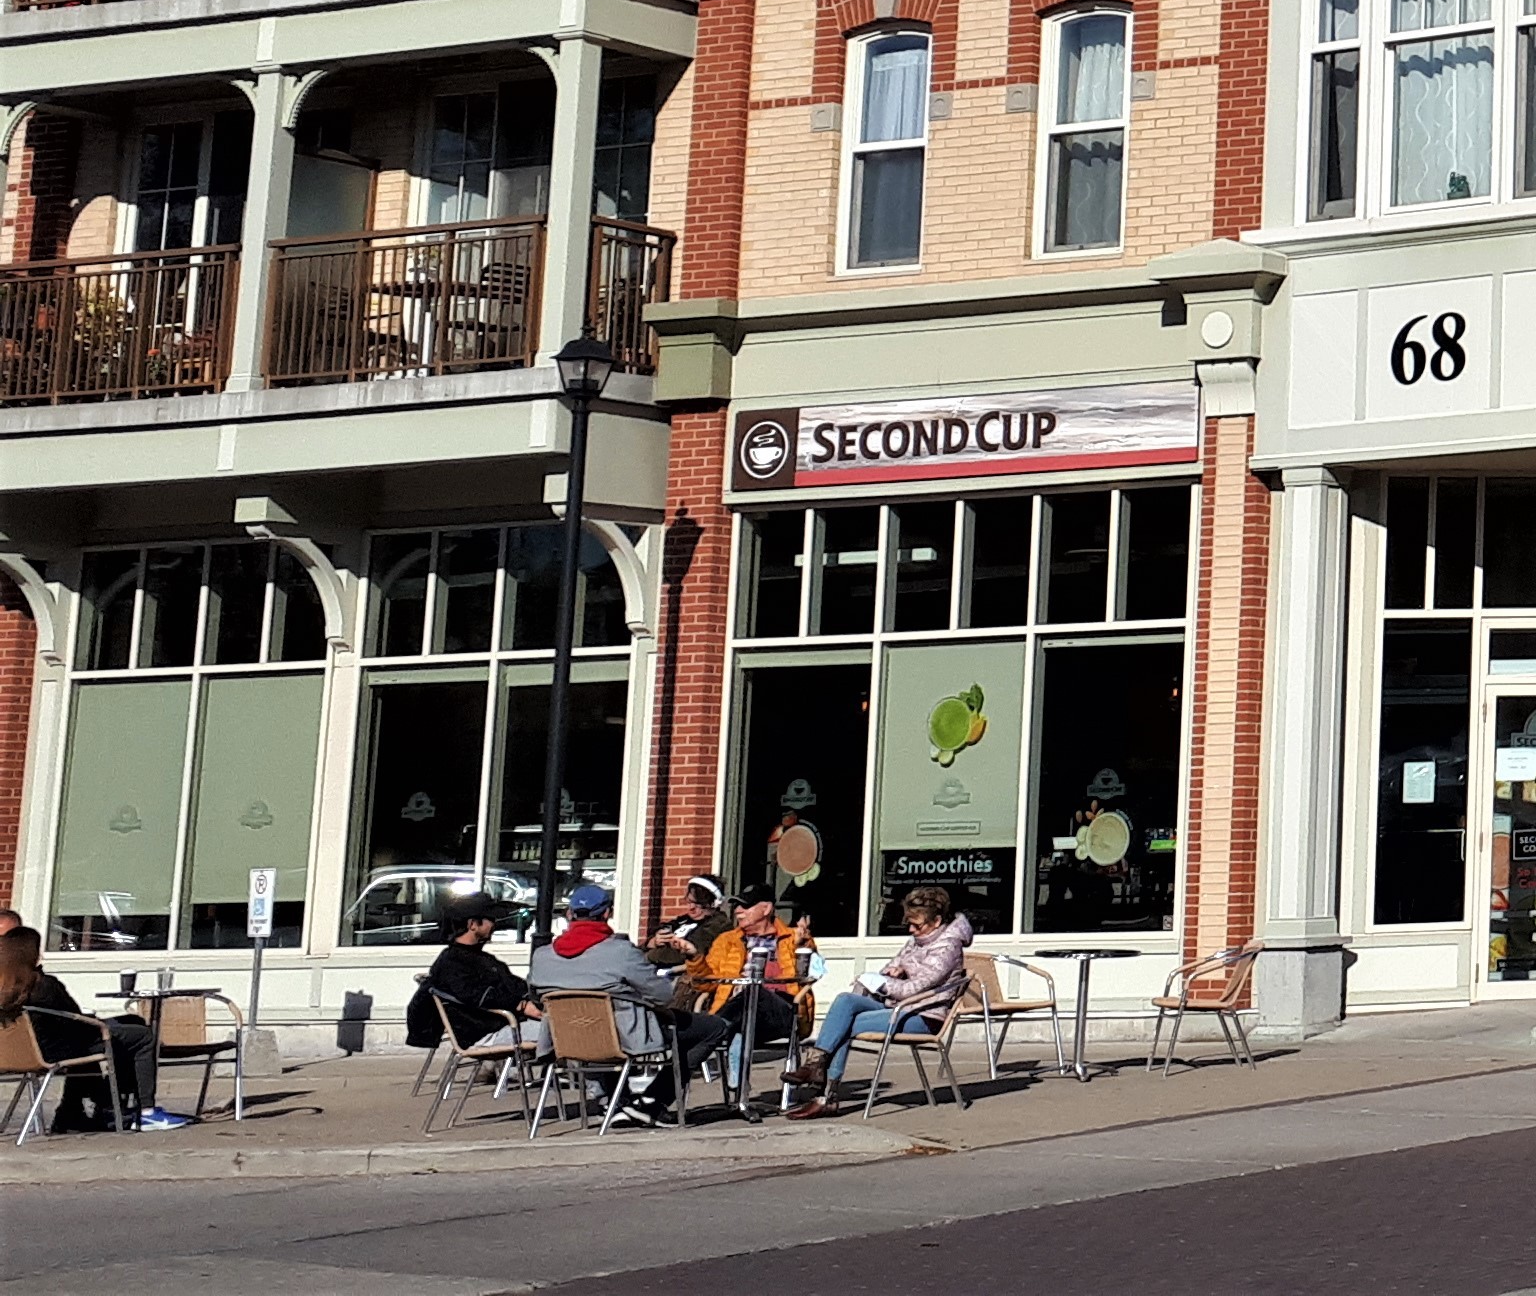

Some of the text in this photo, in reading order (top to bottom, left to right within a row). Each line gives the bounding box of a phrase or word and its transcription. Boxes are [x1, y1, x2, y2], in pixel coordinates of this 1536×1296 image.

[1390, 311, 1466, 386] 68
[811, 410, 1057, 464] SECOND CUP
[897, 855, 993, 874] Smoothies
